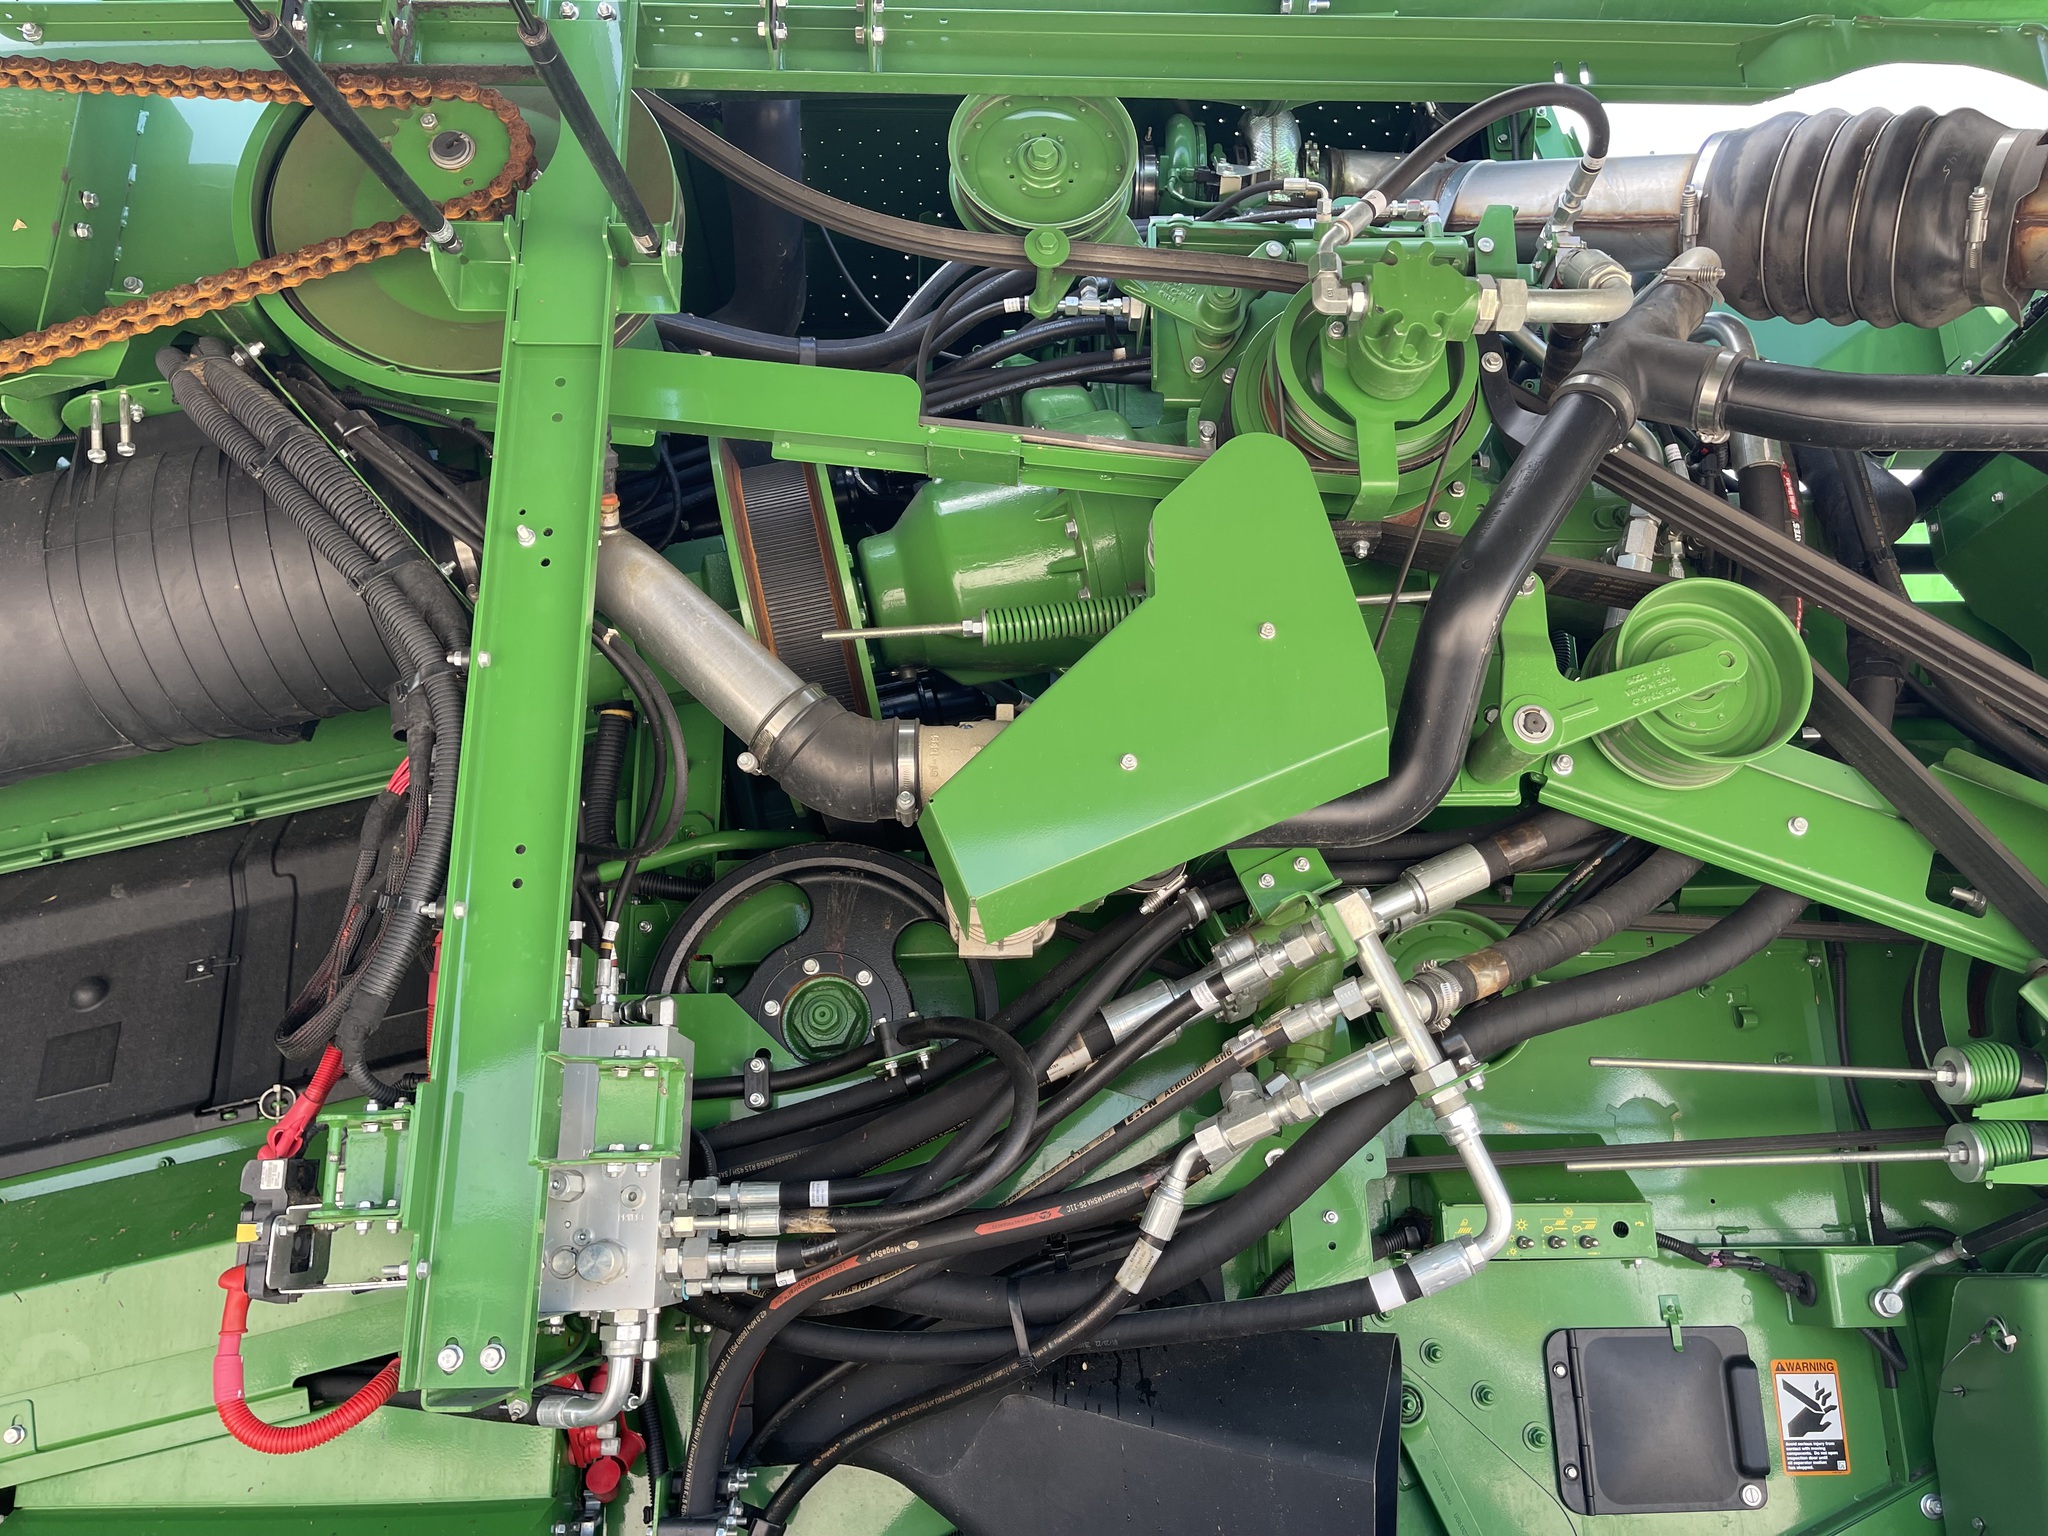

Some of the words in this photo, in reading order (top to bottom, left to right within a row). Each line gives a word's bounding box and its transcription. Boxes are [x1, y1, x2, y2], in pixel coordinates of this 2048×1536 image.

[1162, 1063, 1209, 1097] AEROQUIP
[1085, 1193, 1102, 1206] MSHA
[1101, 1186, 1126, 1200] Resistant
[1065, 1199, 1087, 1213] 2G-11C
[753, 1307, 768, 1321] 42.0
[745, 1317, 758, 1331] MPa
[1053, 1331, 1069, 1345] Flame
[1066, 1317, 1089, 1336] Resistant
[1785, 1362, 1834, 1372] WARNING
[704, 1388, 714, 1399] ISO
[697, 1397, 710, 1414] 3862
[693, 1412, 704, 1426] R15
[689, 1424, 699, 1438] 4SH
[683, 1442, 696, 1469] Exceeds
[681, 1468, 693, 1490] EN856
